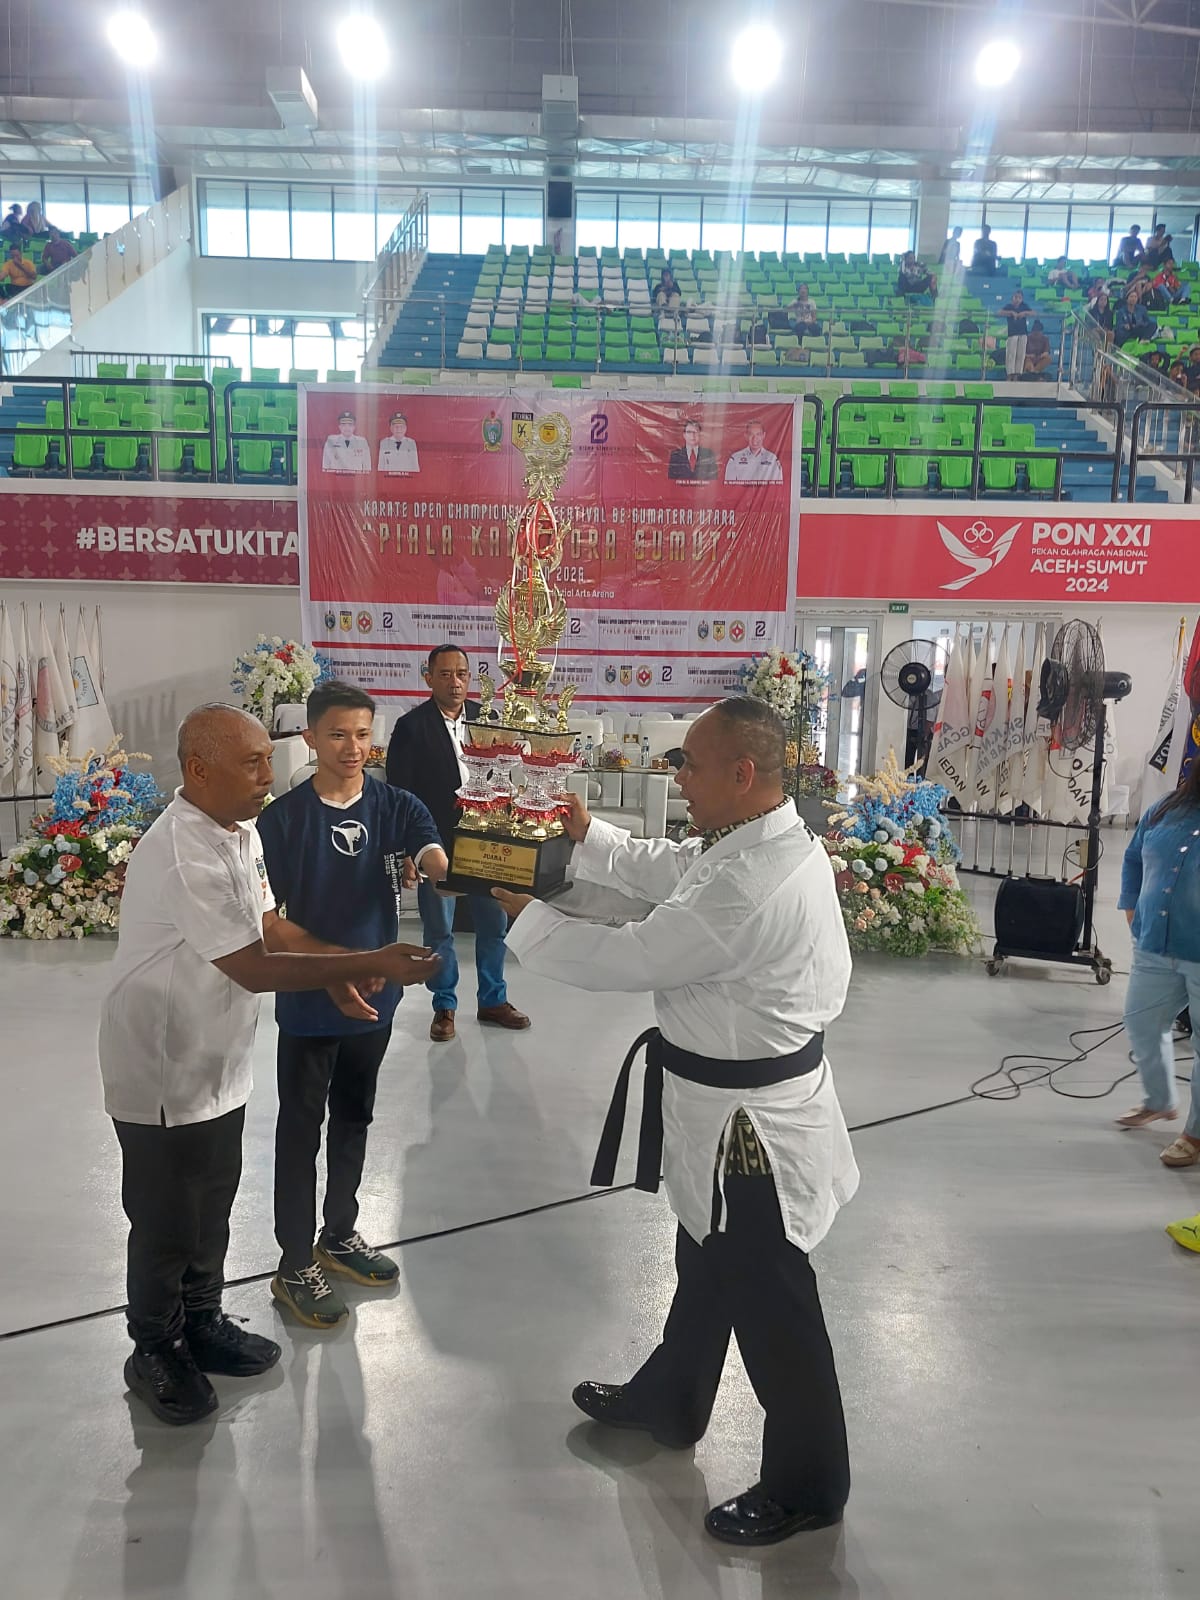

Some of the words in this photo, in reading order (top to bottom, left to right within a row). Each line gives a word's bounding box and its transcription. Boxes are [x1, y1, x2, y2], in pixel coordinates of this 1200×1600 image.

[363, 501, 408, 518] KARATE
[413, 502, 442, 519] OPEN
[632, 507, 693, 524] SUMATERA
[700, 508, 735, 525] UTARA
[76, 526, 299, 556] #BERSATUKITA
[1032, 522, 1096, 546] PON
[1101, 524, 1151, 546] XXI
[1107, 549, 1148, 557] NASIONAL
[1030, 559, 1148, 575] ACEH-SUMUT
[592, 590, 615, 598] Arena
[1065, 577, 1109, 592] 2024
[390, 853, 399, 893] Challenge
